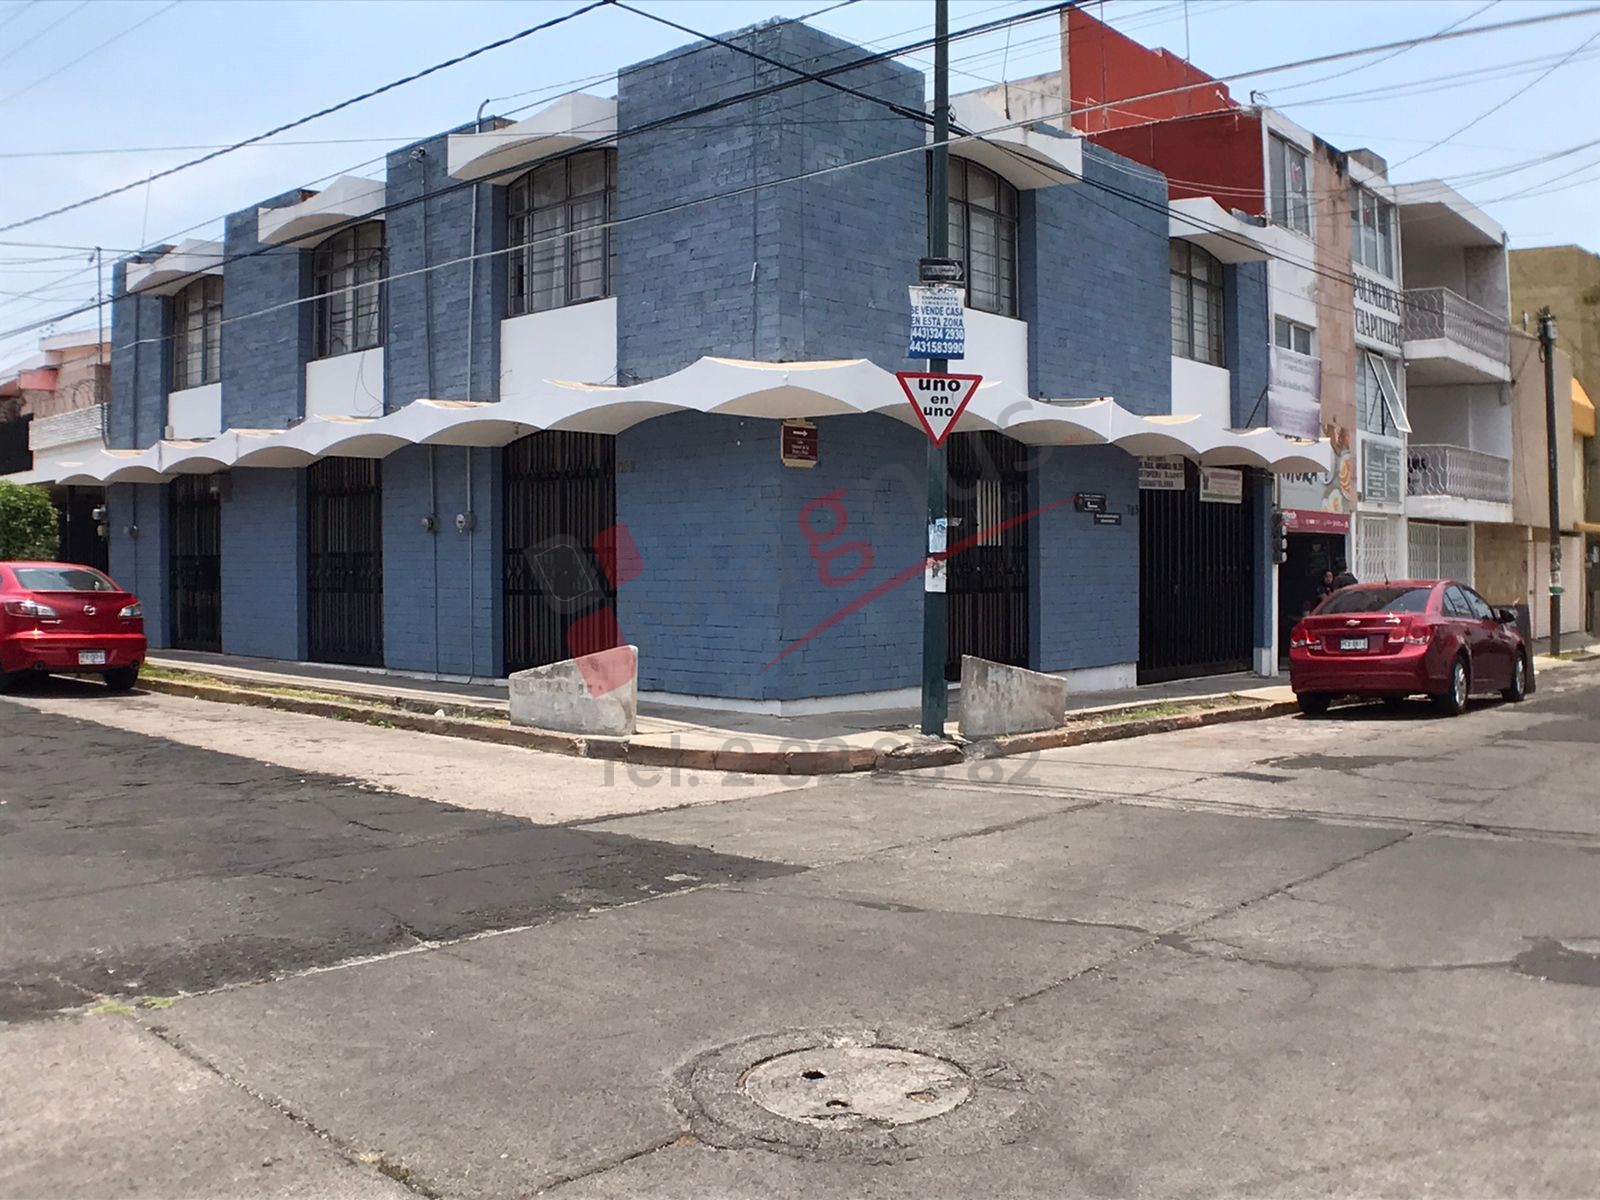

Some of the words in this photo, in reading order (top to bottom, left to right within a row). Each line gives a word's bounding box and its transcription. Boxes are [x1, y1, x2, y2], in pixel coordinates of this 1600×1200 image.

[911, 305, 920, 314] SE
[921, 305, 944, 315] VENDE
[945, 307, 964, 316] CASA
[911, 316, 921, 325] EN
[922, 317, 941, 326] ESTA
[943, 318, 964, 327] ZONA
[918, 379, 961, 392] uno
[930, 395, 949, 405] en
[923, 406, 954, 417] uno
